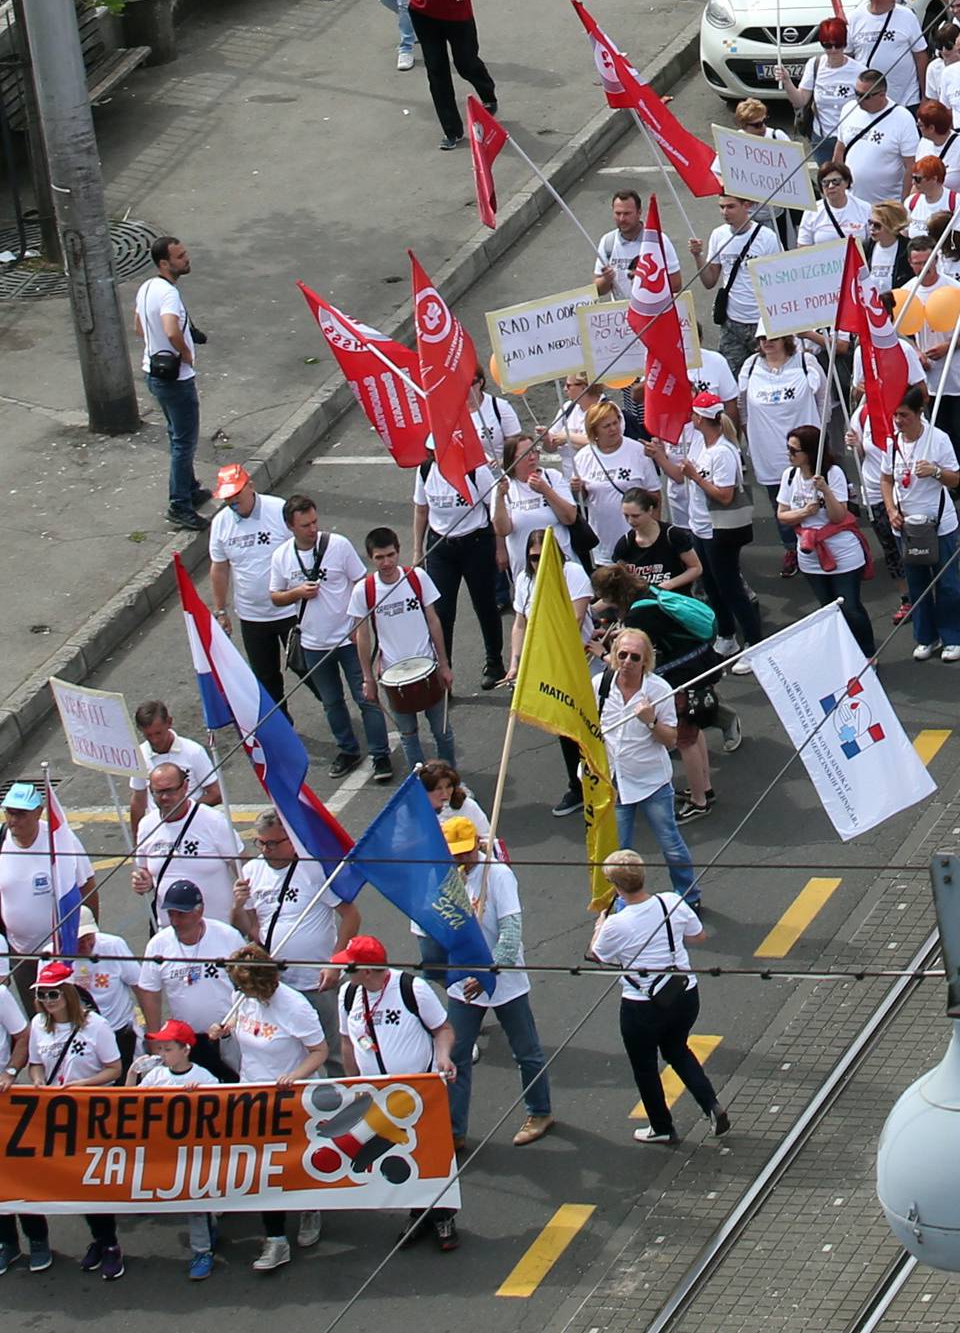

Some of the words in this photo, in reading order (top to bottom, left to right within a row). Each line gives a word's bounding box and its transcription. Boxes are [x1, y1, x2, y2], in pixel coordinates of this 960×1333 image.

[726, 140, 735, 157] S
[744, 145, 788, 169] POSLA
[730, 167, 748, 184] NA
[759, 274, 772, 287] MI
[775, 268, 796, 284] SMO
[766, 304, 778, 317] VI
[780, 301, 800, 314] STE
[498, 316, 530, 336] RAD
[536, 310, 554, 329] NA
[528, 344, 543, 357] NA
[538, 681, 577, 711] MATICA
[5, 1094, 79, 1158] ZA
[86, 1089, 297, 1141] REFORME
[81, 1146, 127, 1186] ZA
[130, 1141, 288, 1200] LJUDE
